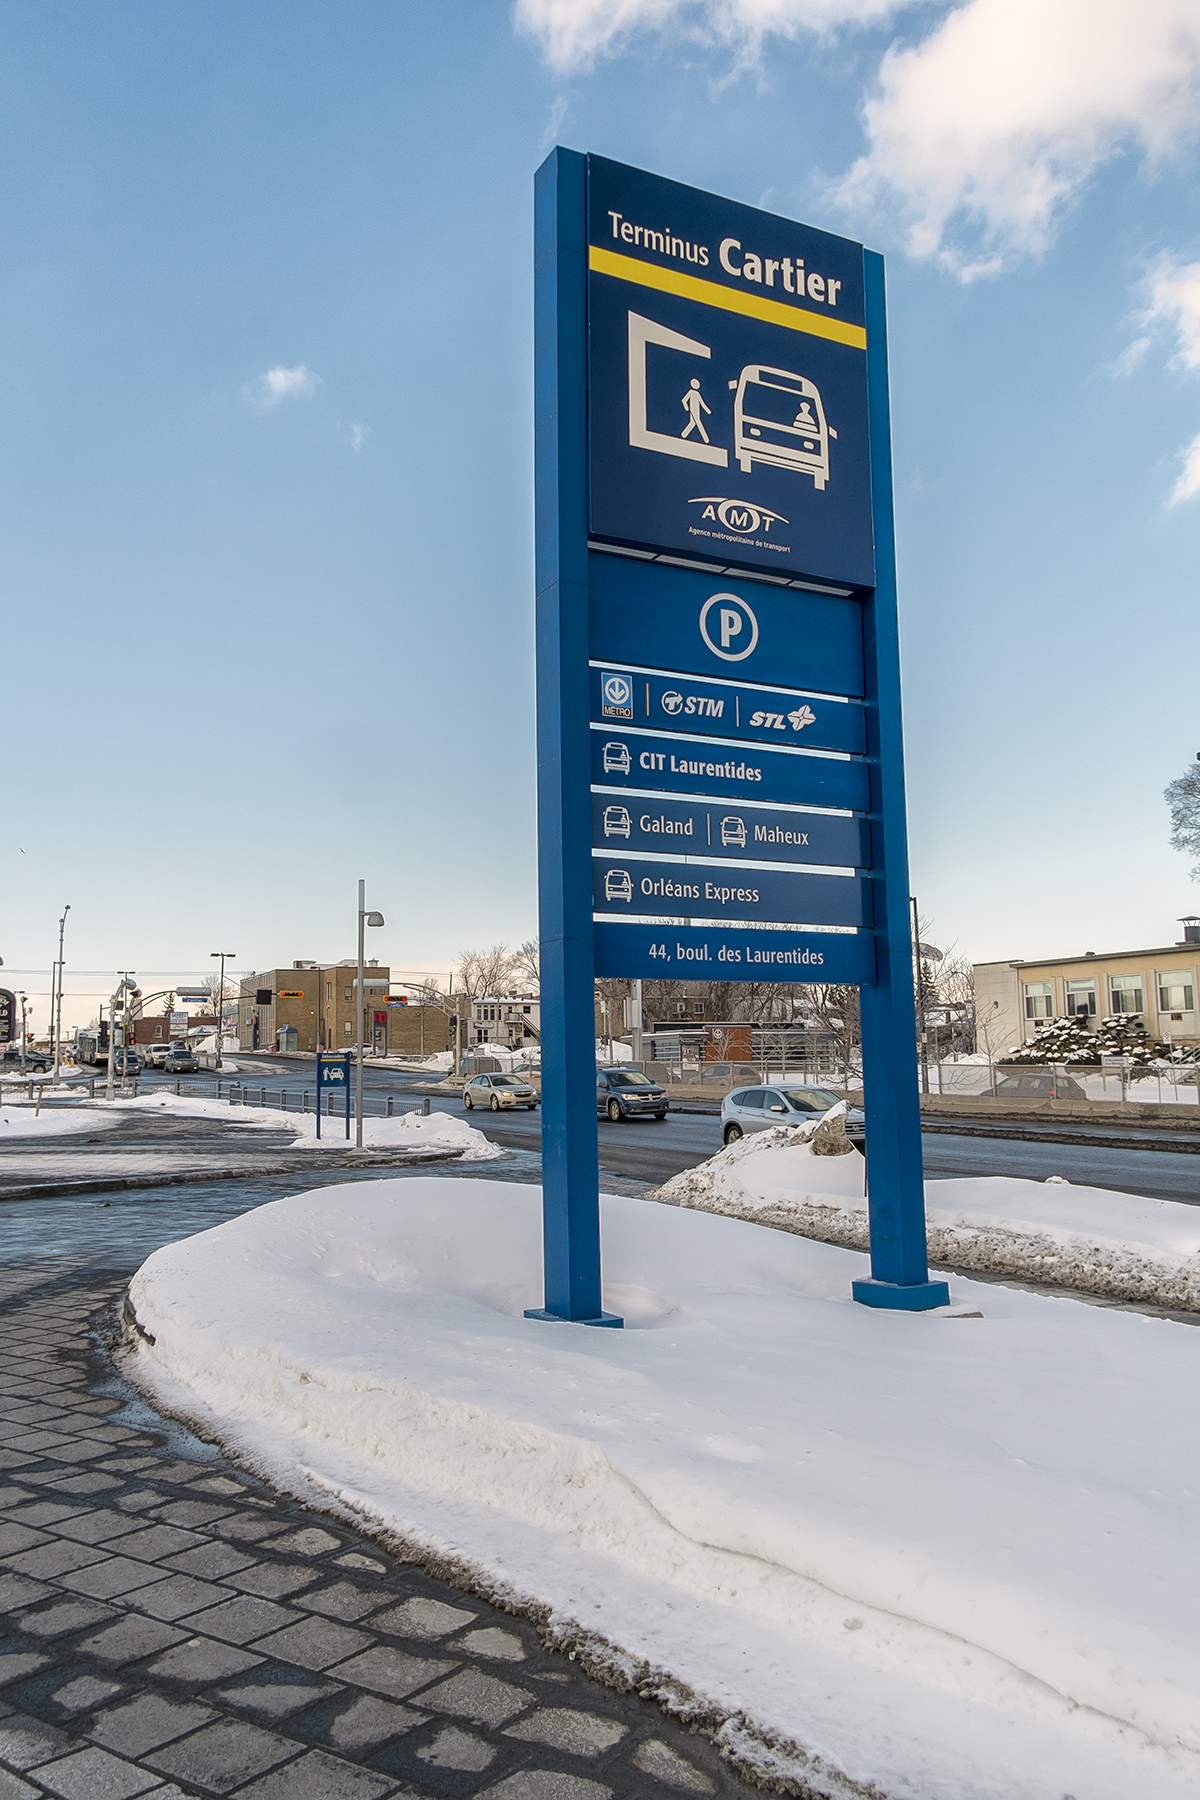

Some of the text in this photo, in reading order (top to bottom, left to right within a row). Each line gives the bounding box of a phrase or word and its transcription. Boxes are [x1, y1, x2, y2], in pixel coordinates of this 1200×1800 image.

[608, 211, 841, 306] Terminus Cartier
[701, 504, 775, 532] AMT
[688, 526, 791, 554] Agence métropolitaine de transport
[719, 609, 742, 648] P
[684, 696, 725, 718] STM
[749, 711, 787, 730] STL
[639, 751, 762, 782] CIT Laurentides
[639, 814, 693, 836] Galand
[754, 825, 809, 846] Maheux
[640, 877, 760, 904] Orléans Express
[648, 943, 824, 965] 44, boul. des Laurentides
